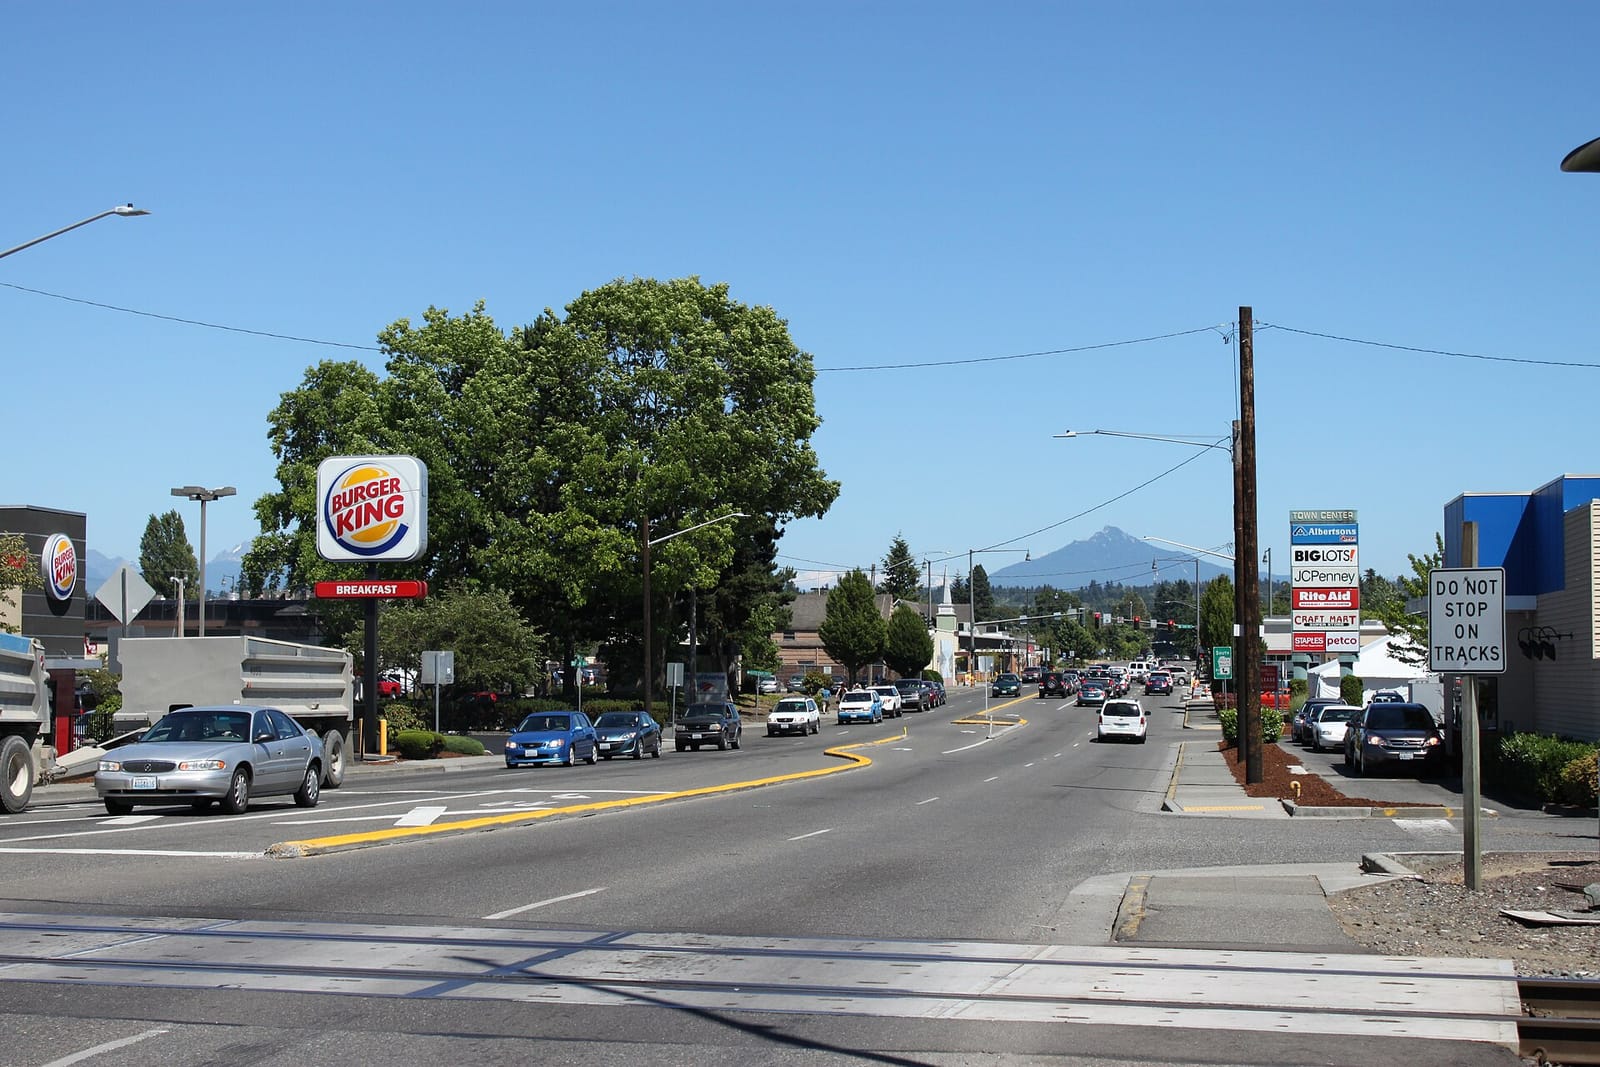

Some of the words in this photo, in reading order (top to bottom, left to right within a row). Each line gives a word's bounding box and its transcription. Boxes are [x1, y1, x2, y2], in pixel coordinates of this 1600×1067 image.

[332, 477, 401, 516] BURGER
[336, 494, 405, 538] KING
[1293, 511, 1318, 520] TOWN
[1320, 511, 1354, 520] CENTER
[1309, 527, 1357, 536] Albertsons
[54, 547, 74, 569] BURGER
[55, 558, 75, 585] KING
[1294, 570, 1356, 585] JCPenney
[336, 585, 398, 595] BREAKFAST
[1436, 580, 1459, 596] DO
[1466, 579, 1498, 595] NOT
[1445, 602, 1488, 617] STOP
[1294, 615, 1324, 625] CRAFT
[1329, 615, 1357, 625] MART
[1454, 624, 1478, 639] ON
[1294, 636, 1324, 645] STAPLES
[1327, 637, 1358, 647] petco
[1434, 645, 1500, 661] TRACKS
